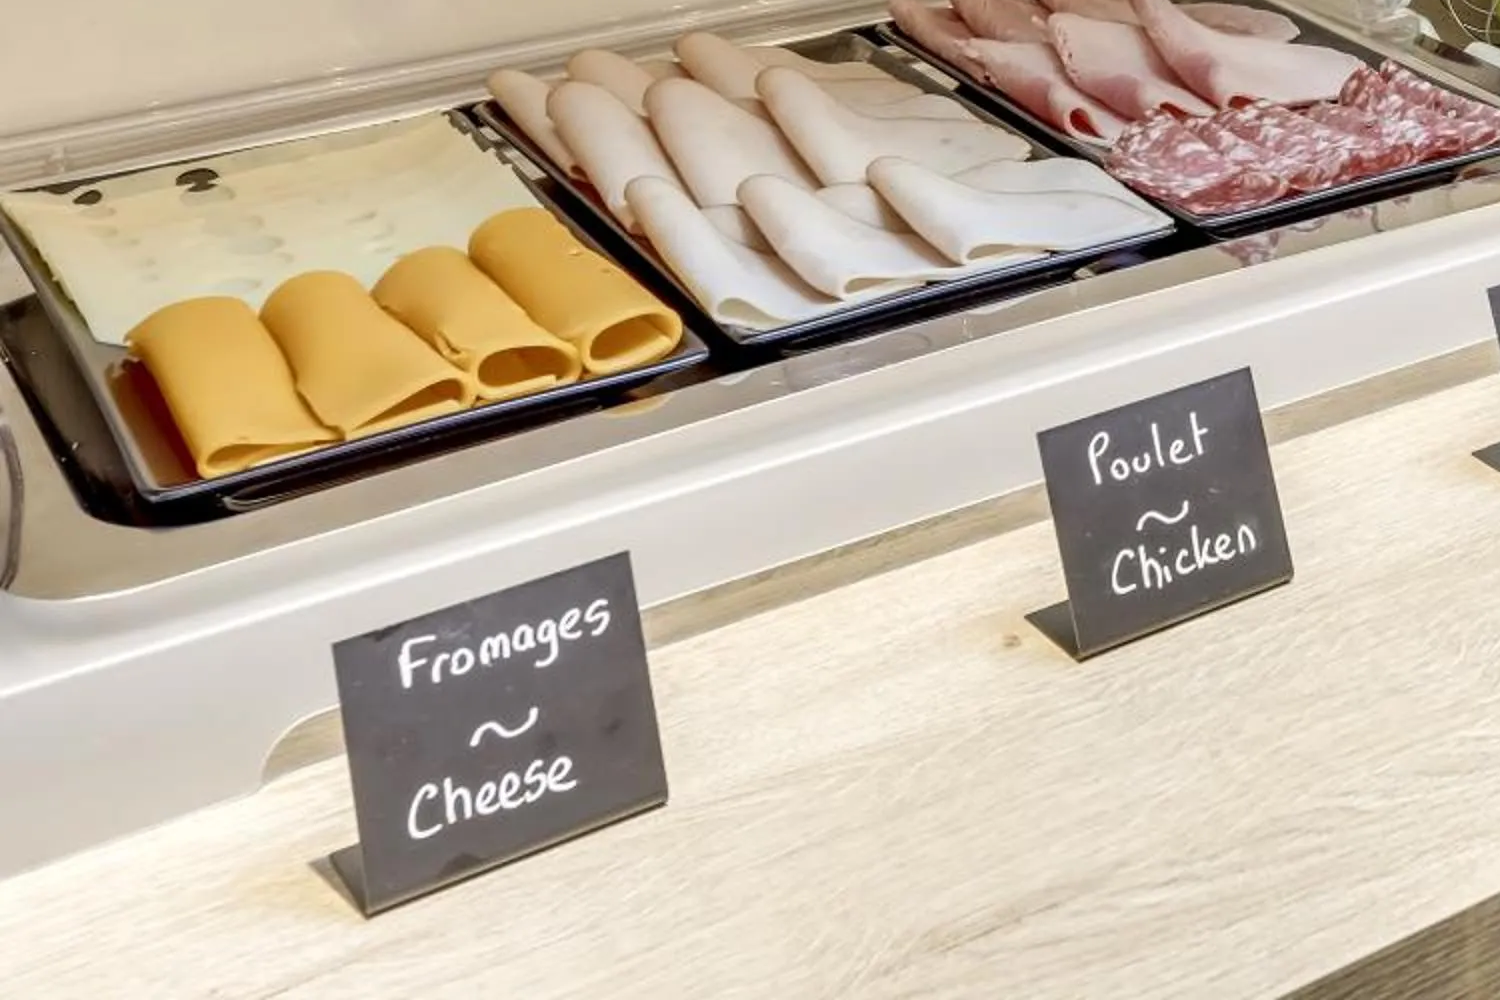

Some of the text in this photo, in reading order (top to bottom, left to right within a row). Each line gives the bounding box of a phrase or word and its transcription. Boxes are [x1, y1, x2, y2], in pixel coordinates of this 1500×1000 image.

[1087, 411, 1209, 485] Poulet
[1111, 524, 1257, 595] Chicken
[398, 598, 611, 689] Fromages
[408, 755, 580, 839] Cheese
